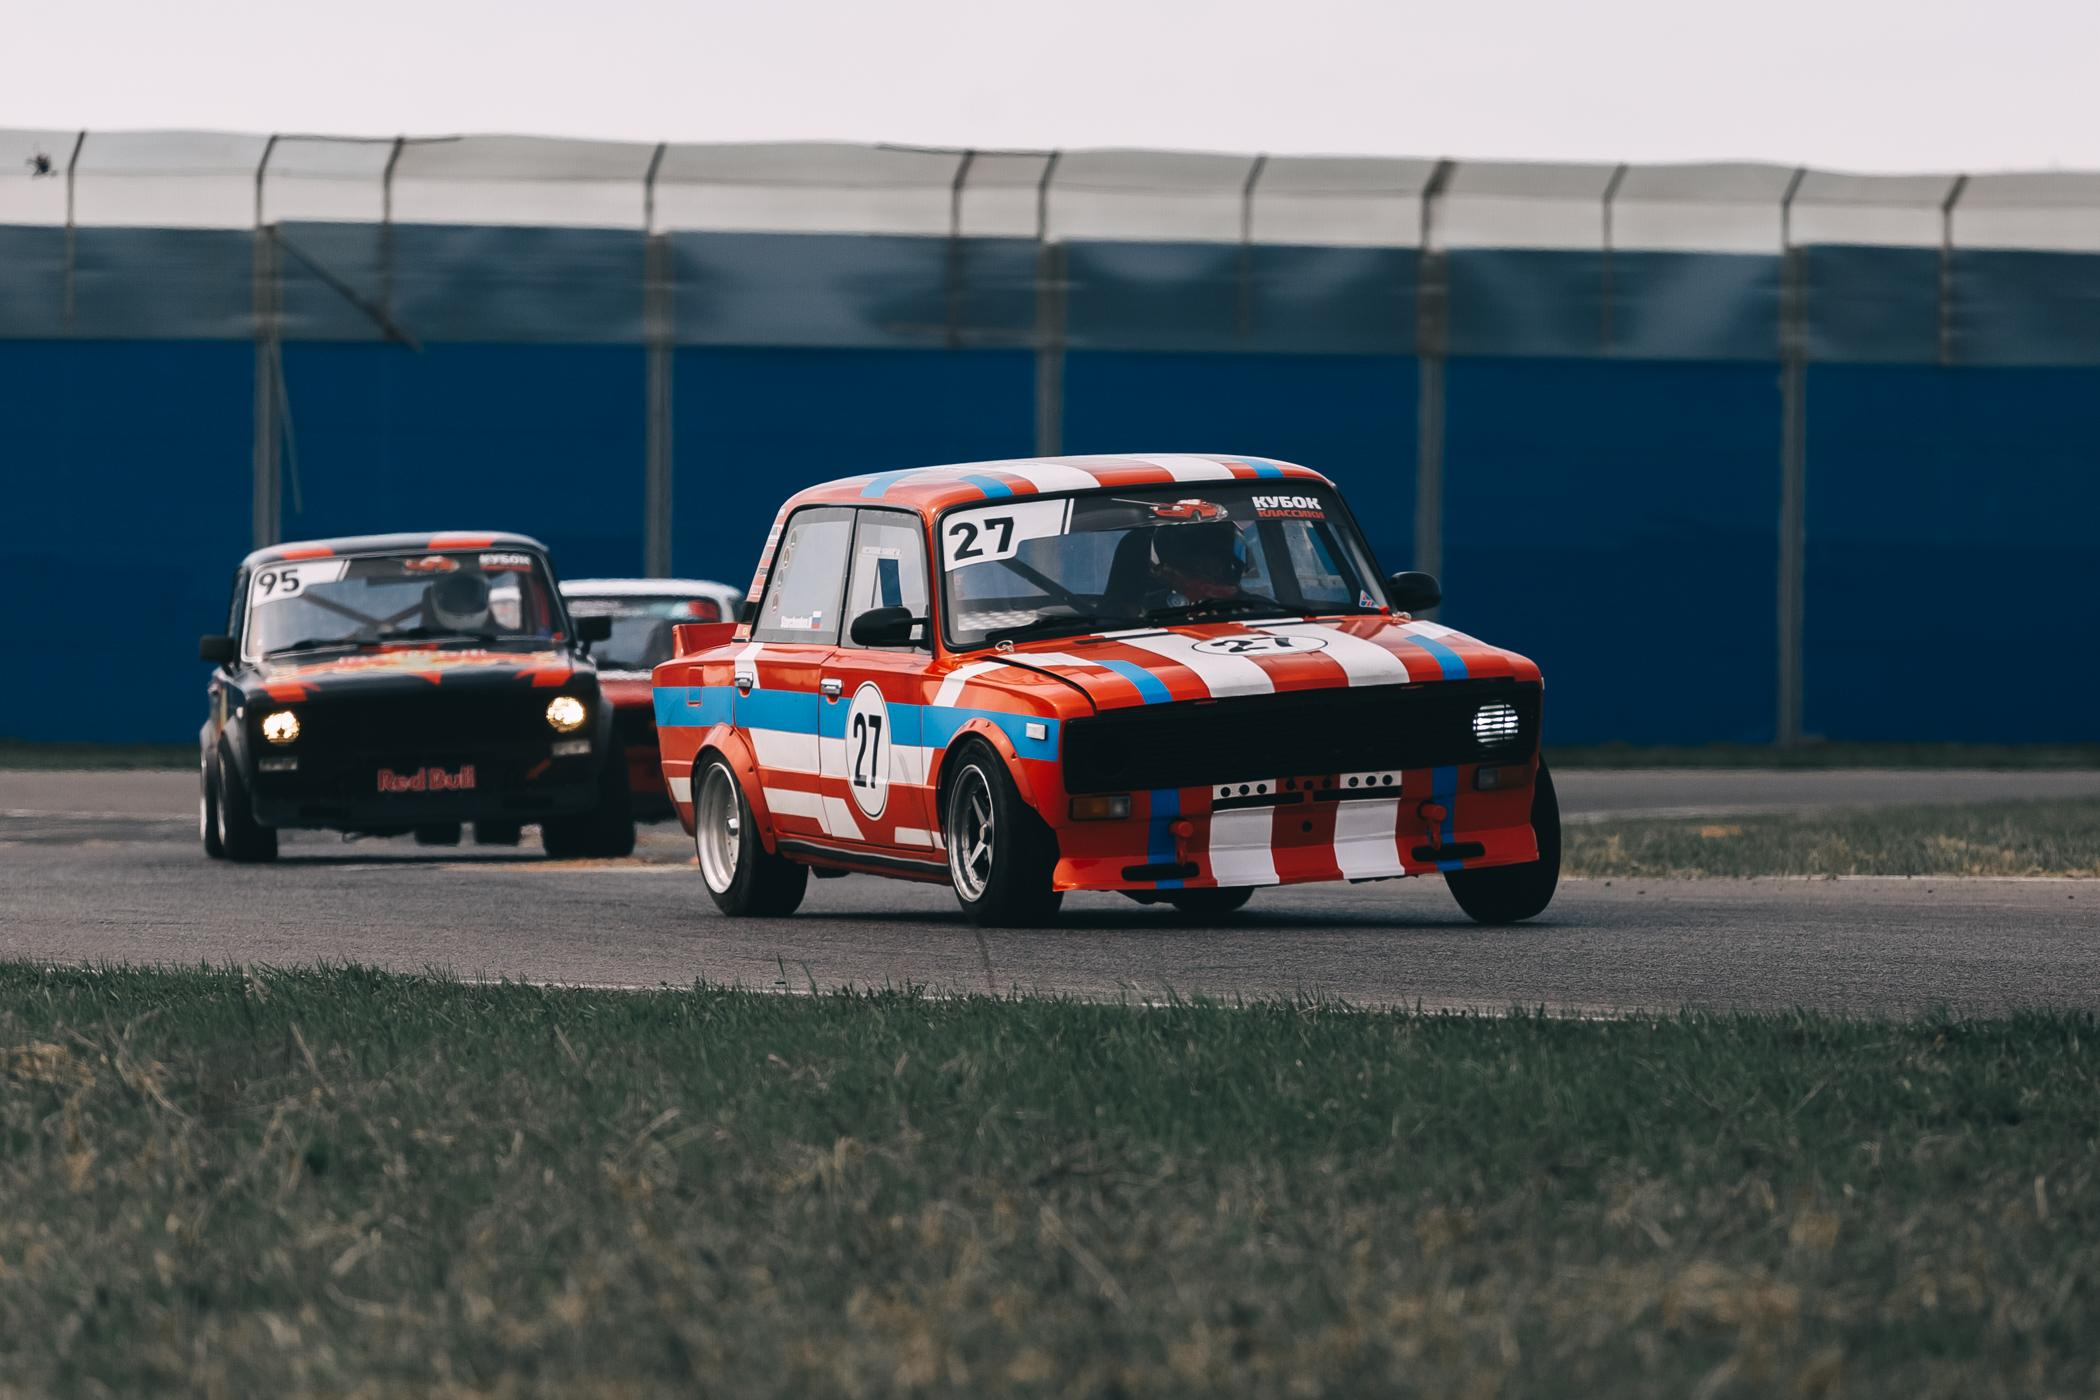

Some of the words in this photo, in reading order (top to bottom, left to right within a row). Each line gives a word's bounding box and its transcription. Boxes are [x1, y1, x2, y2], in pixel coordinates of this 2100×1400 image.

[1252, 496, 1321, 509] КУБОК
[1257, 509, 1325, 518] КЛАССИКИ
[949, 516, 1014, 561] 27
[259, 568, 299, 596] 95
[1210, 637, 1292, 652] 27
[853, 712, 881, 789] 27
[377, 767, 426, 792] Red
[429, 764, 475, 790] Bull
